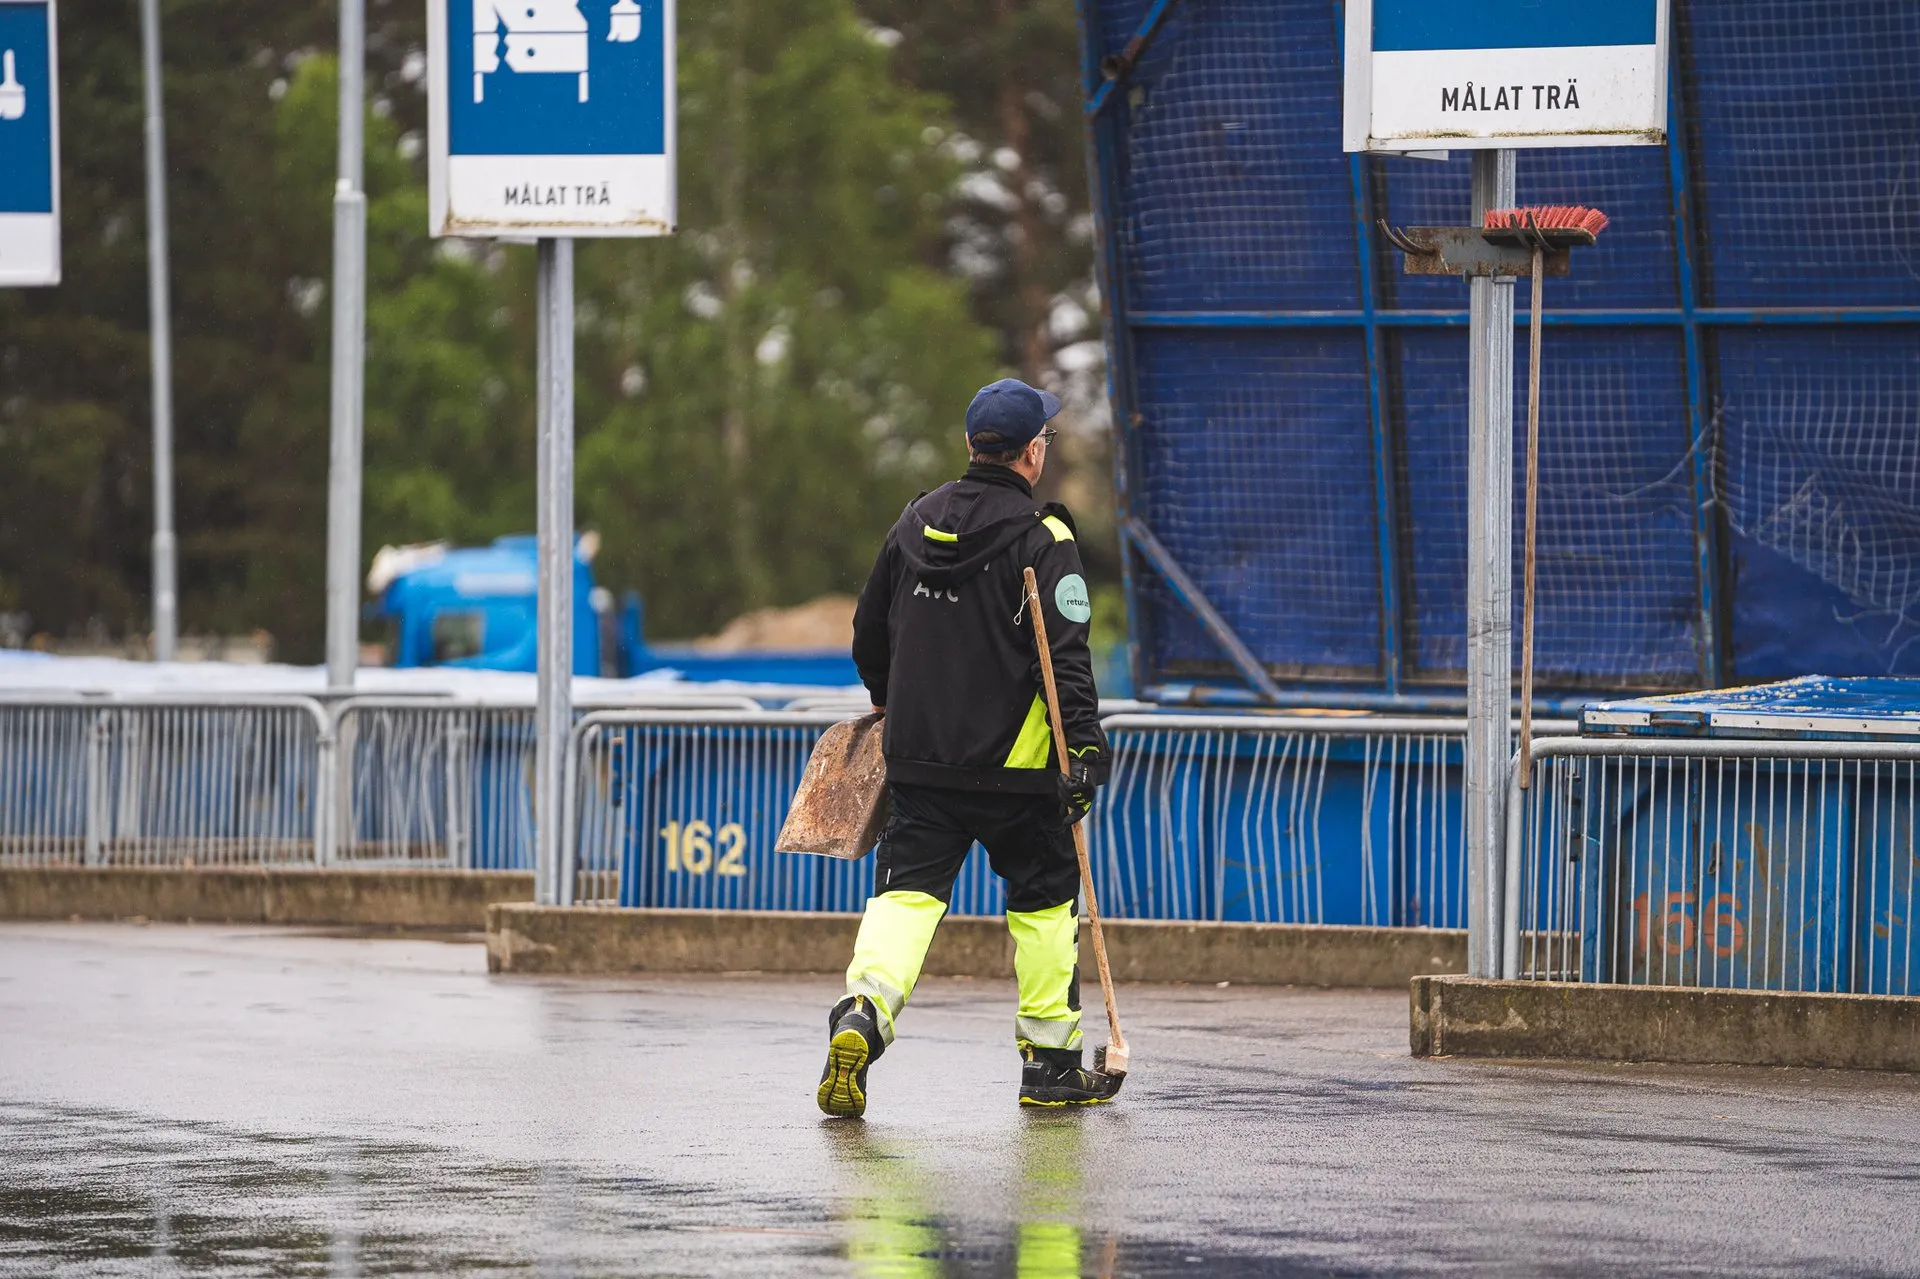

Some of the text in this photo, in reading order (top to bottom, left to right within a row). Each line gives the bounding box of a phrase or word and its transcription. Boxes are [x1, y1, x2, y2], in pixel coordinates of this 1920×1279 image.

[1441, 78, 1580, 112] MÅLAT TRÄ
[504, 180, 611, 205] MÅLAT TRÄ
[660, 819, 747, 876] 162
[1627, 891, 1744, 958] 156
